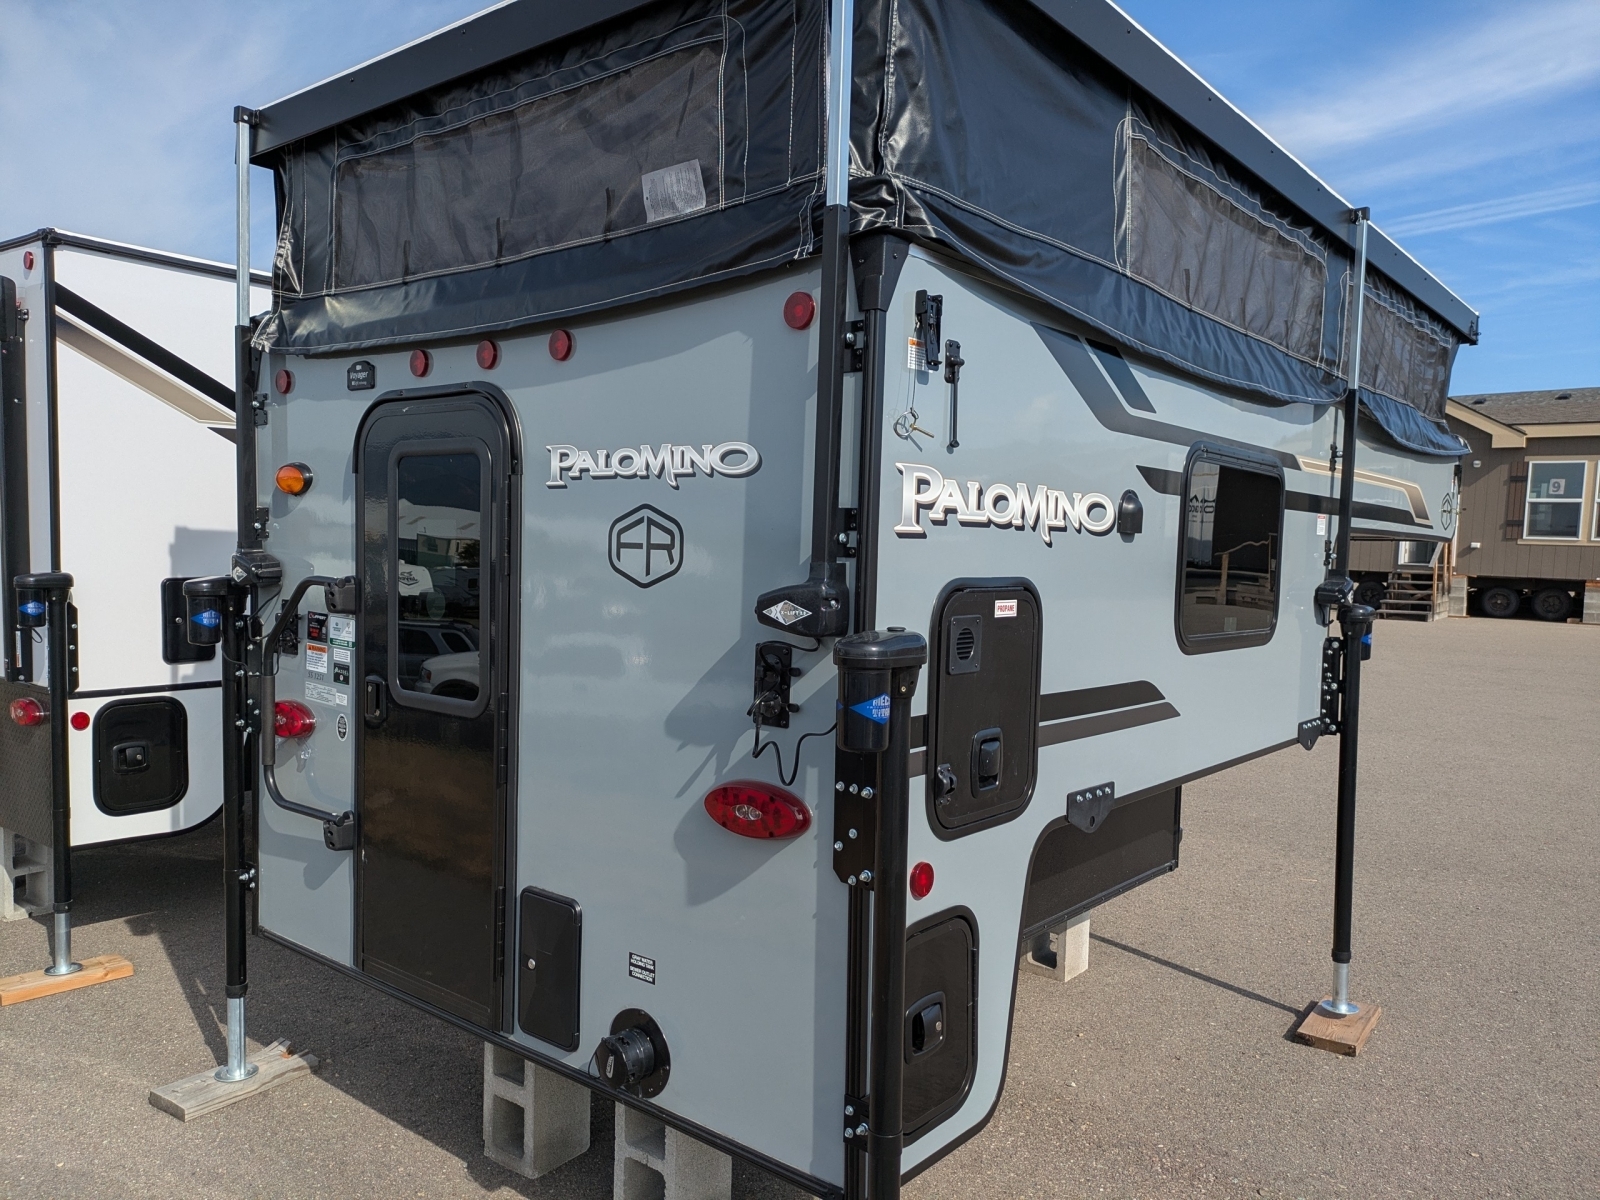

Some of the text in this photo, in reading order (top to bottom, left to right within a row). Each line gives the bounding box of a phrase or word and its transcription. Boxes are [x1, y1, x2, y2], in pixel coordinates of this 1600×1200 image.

[350, 371, 368, 379] Voyager
[1551, 481, 1561, 493] 9
[997, 604, 1015, 612] PROPANE
[631, 958, 646, 967] HOLDING
[641, 957, 653, 965] WATER
[632, 971, 653, 982] CONNECTION
[641, 970, 655, 978] OUTLET
